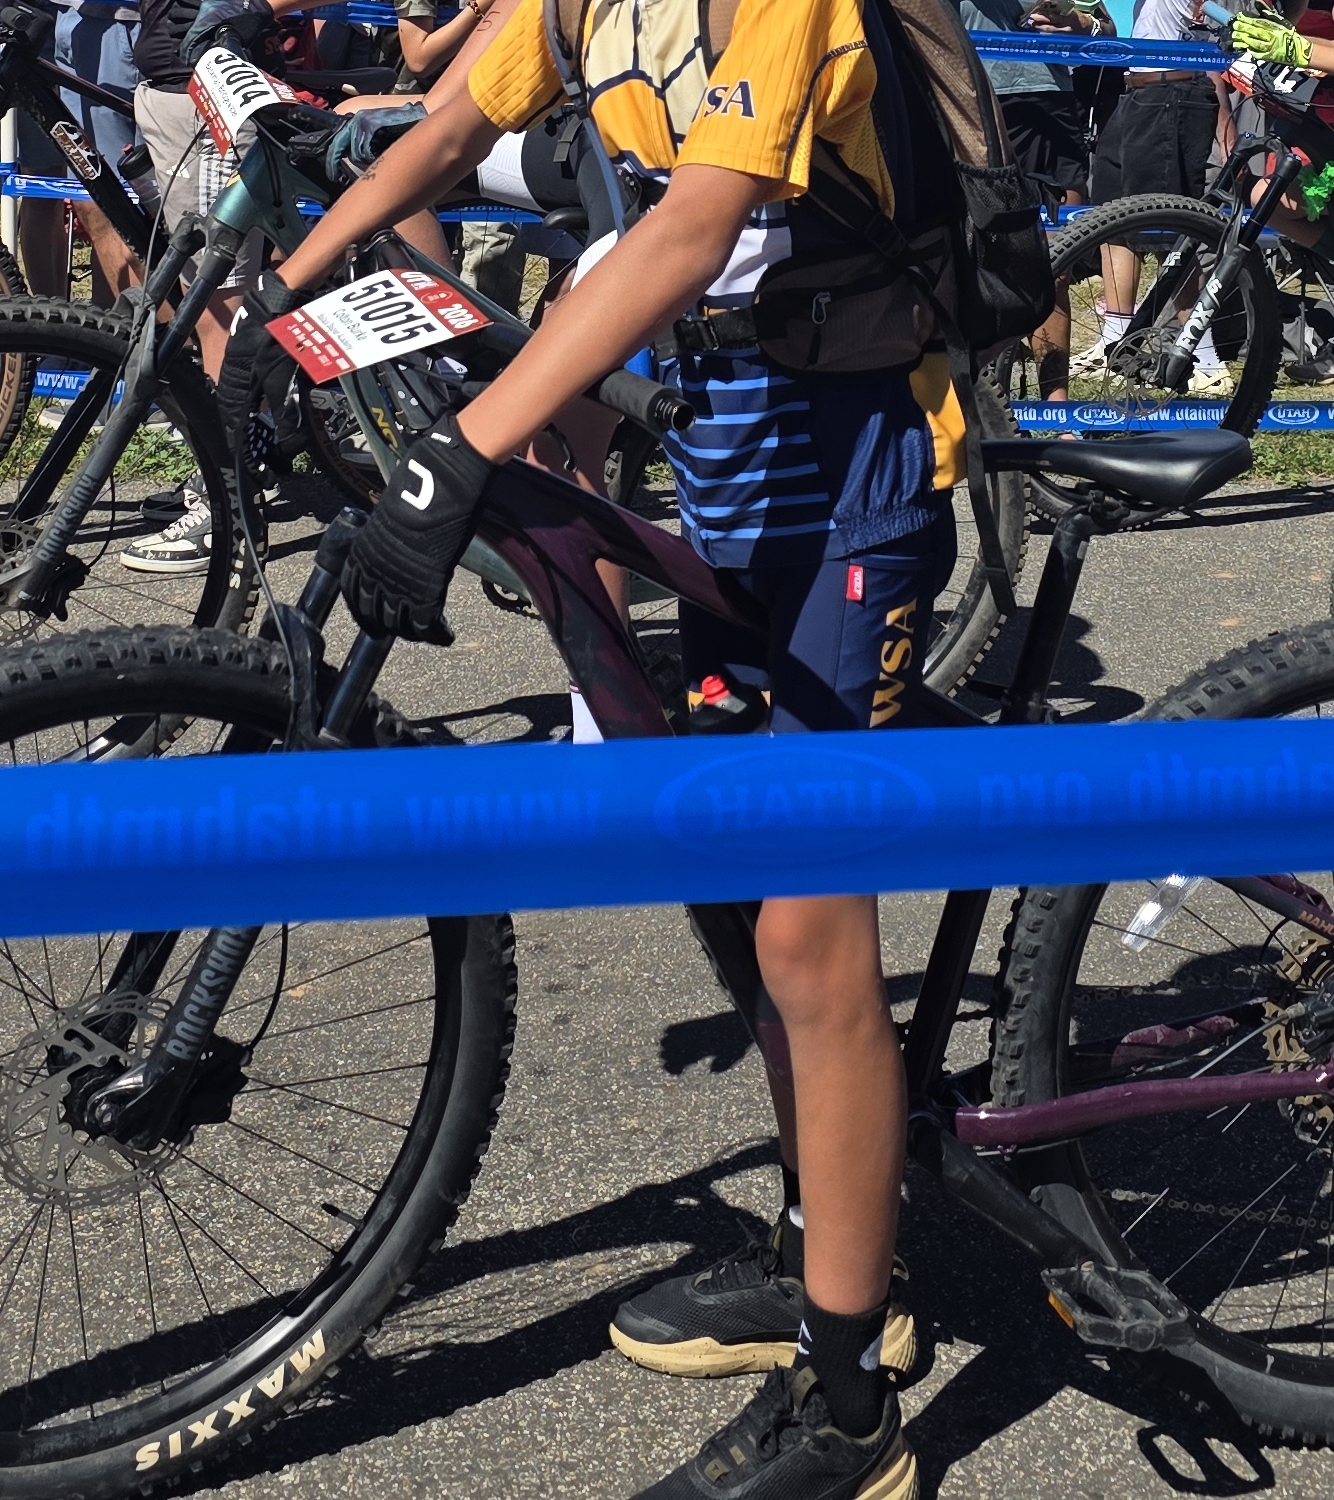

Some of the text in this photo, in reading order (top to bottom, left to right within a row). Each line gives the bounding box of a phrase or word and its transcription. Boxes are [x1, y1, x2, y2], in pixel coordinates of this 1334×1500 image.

[691, 80, 755, 123] SA
[341, 279, 438, 345] 51015
[1175, 301, 1215, 353] FOX
[1082, 407, 1118, 420] UTAH
[1276, 405, 1311, 419] UTAH
[36, 473, 97, 563] ROCKSHOX
[869, 597, 917, 729] WSA
[133, 1328, 327, 1473] MAXXIS
